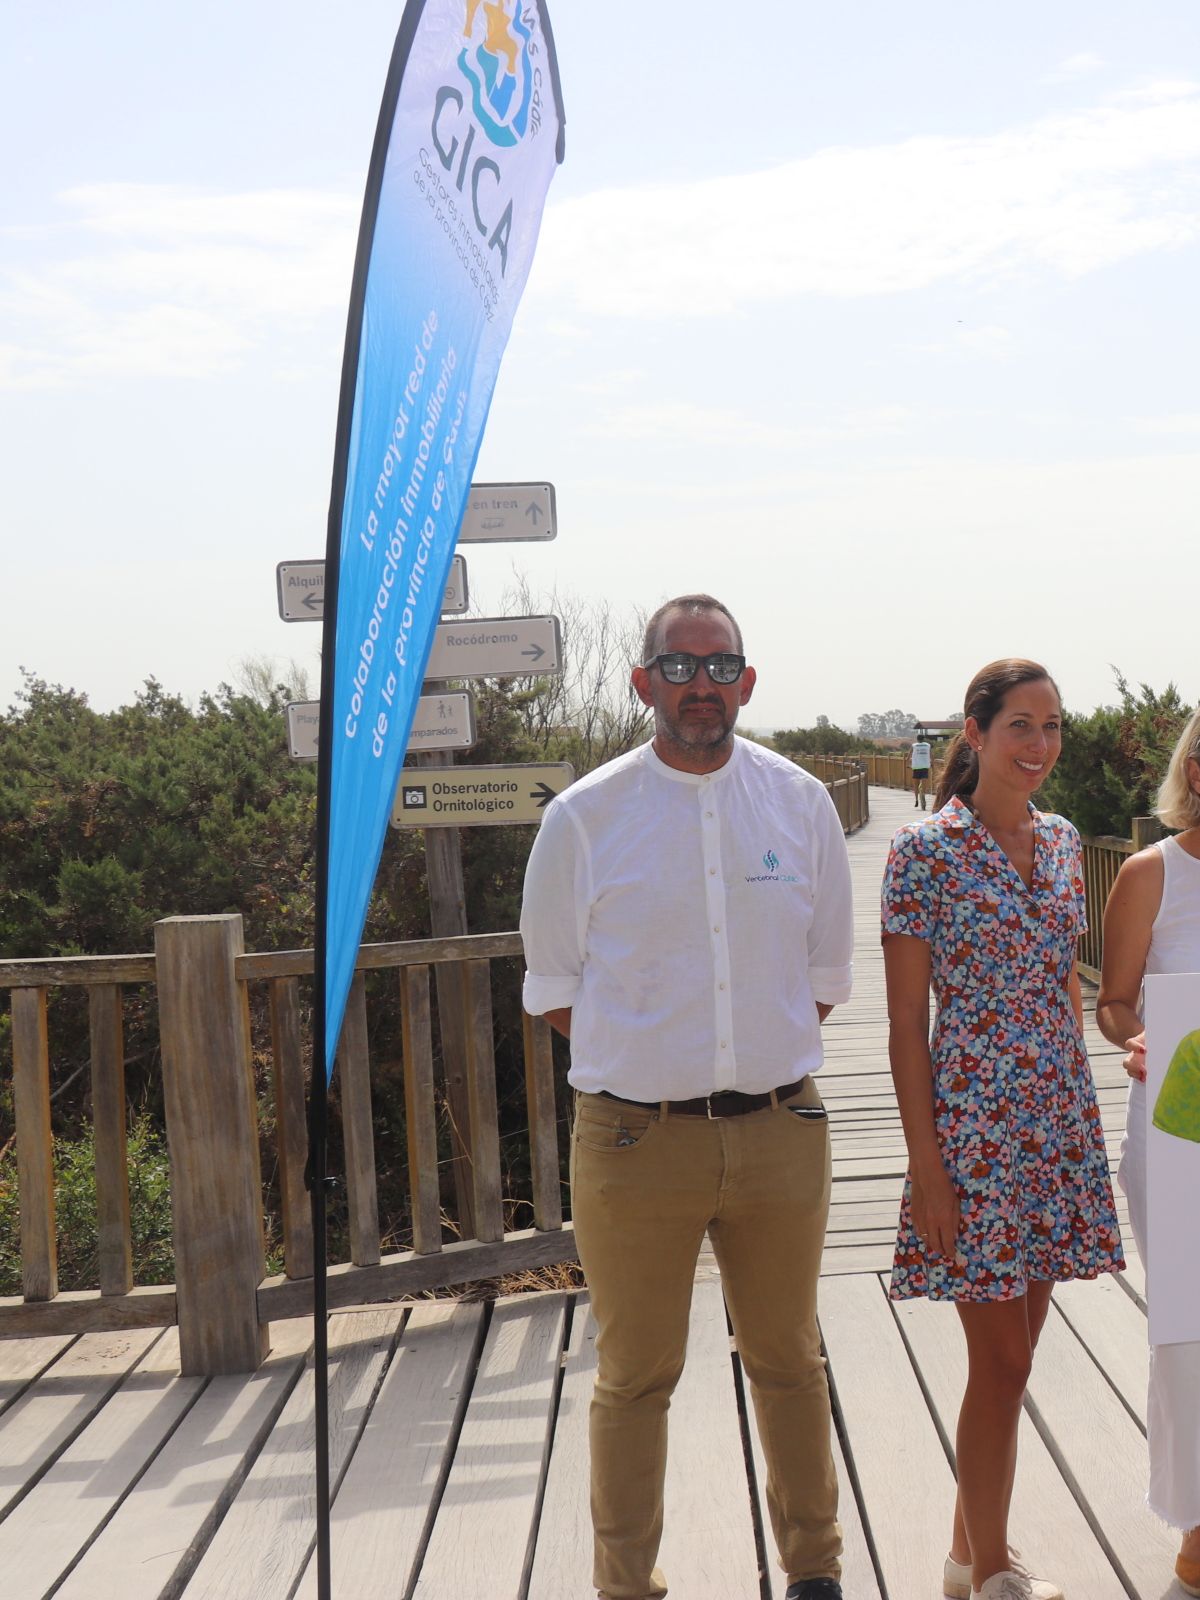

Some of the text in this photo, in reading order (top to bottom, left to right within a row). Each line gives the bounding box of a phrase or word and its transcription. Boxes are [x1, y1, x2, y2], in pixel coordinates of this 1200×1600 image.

[413, 170, 426, 193] de
[426, 194, 436, 210] la
[435, 212, 470, 270] provincia
[469, 268, 481, 289] de
[419, 147, 458, 220] Gestores
[431, 86, 513, 279] GICA
[361, 307, 440, 552] La mayor red de
[399, 347, 457, 516] inmobiliaria
[472, 499, 518, 510] en tren
[372, 716, 388, 758] de
[381, 671, 397, 707] la
[394, 515, 436, 666] provincia
[431, 469, 445, 512] de
[447, 633, 518, 647] Rocódromo
[432, 781, 518, 795] Observatorio
[432, 799, 514, 814] Ornitológico
